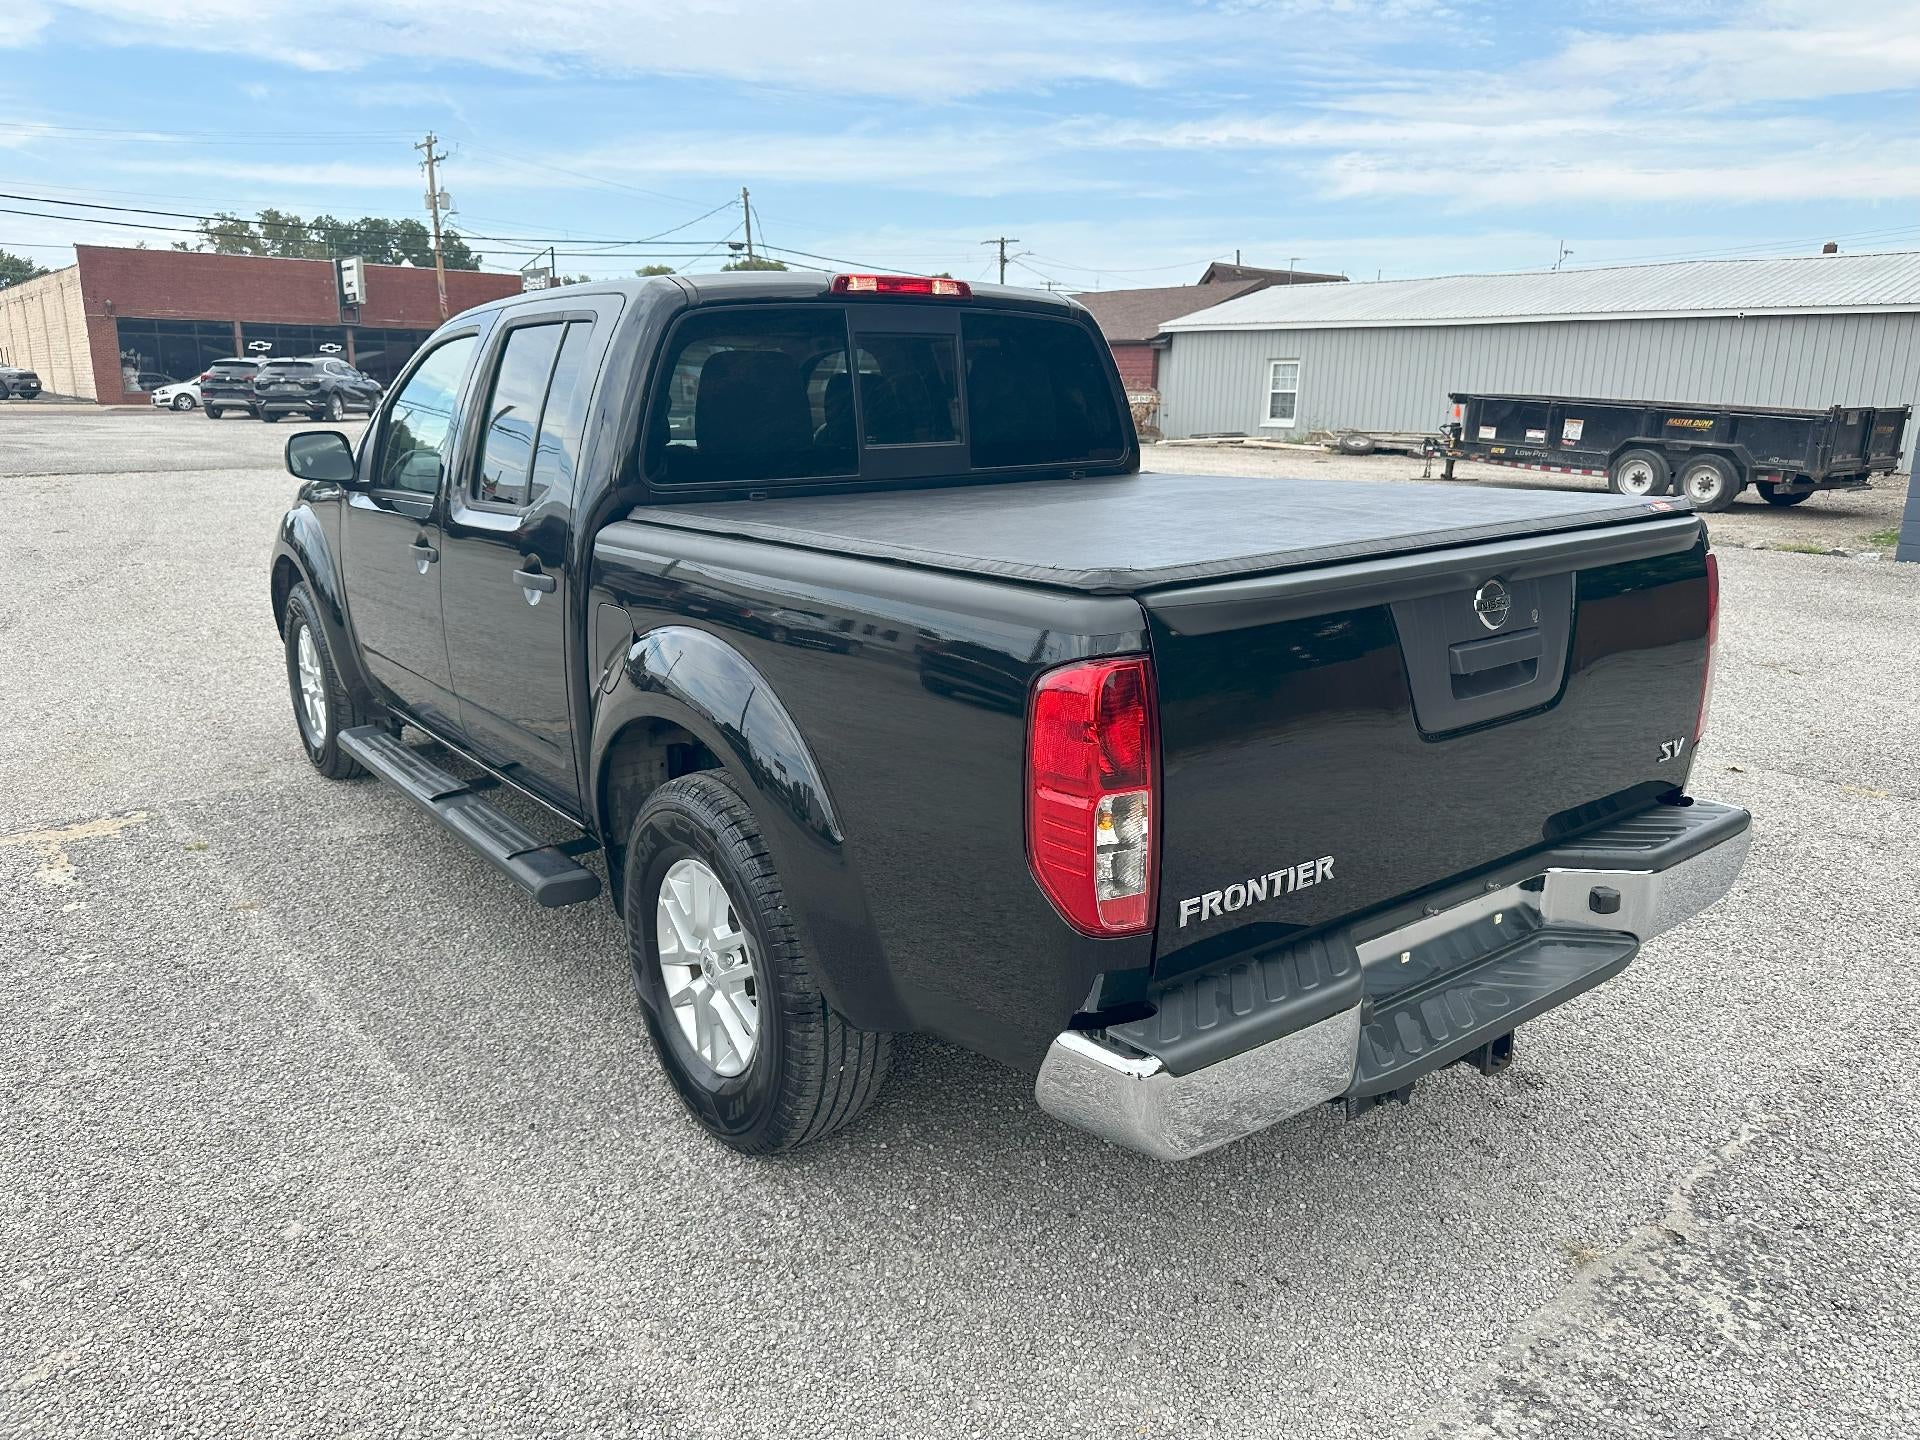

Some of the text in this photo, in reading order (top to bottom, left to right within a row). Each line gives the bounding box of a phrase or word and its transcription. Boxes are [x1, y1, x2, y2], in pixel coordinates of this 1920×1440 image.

[1694, 420, 1715, 428] DUMP
[1656, 737, 1685, 763] SV
[1178, 855, 1335, 929] FRONTIER
